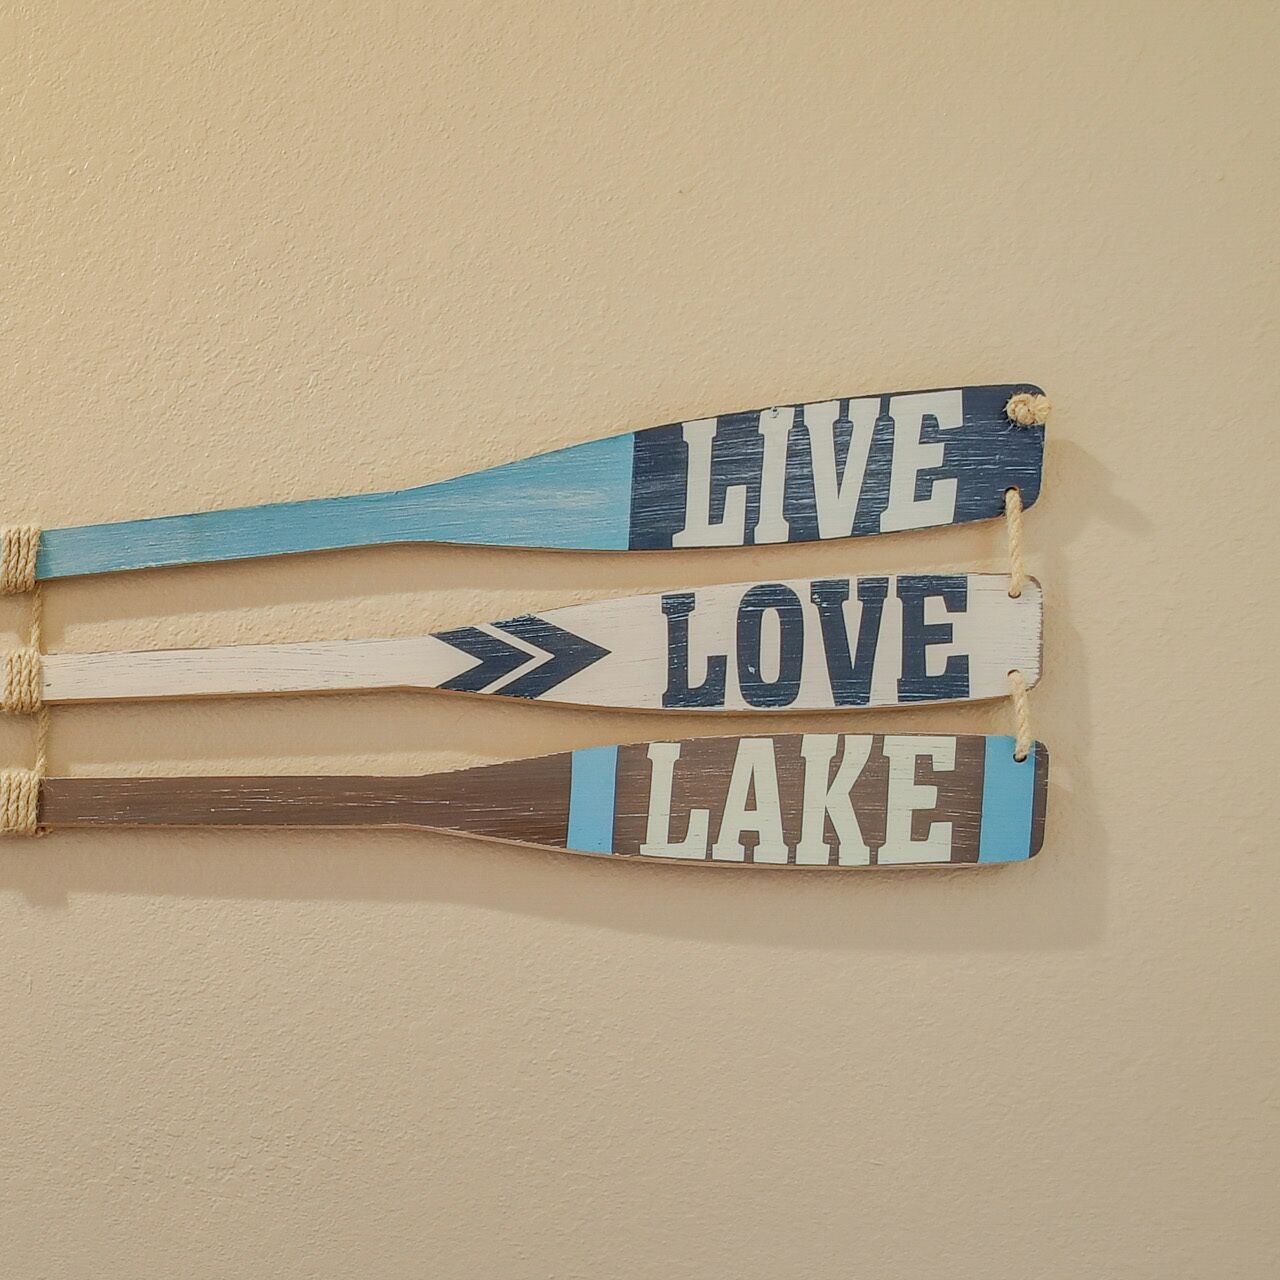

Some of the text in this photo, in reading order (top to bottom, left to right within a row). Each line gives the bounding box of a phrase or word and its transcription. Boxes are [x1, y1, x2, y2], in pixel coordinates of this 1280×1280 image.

[671, 388, 964, 549] LIVE
[661, 574, 970, 709] LOVE
[640, 734, 957, 866] LAKE
